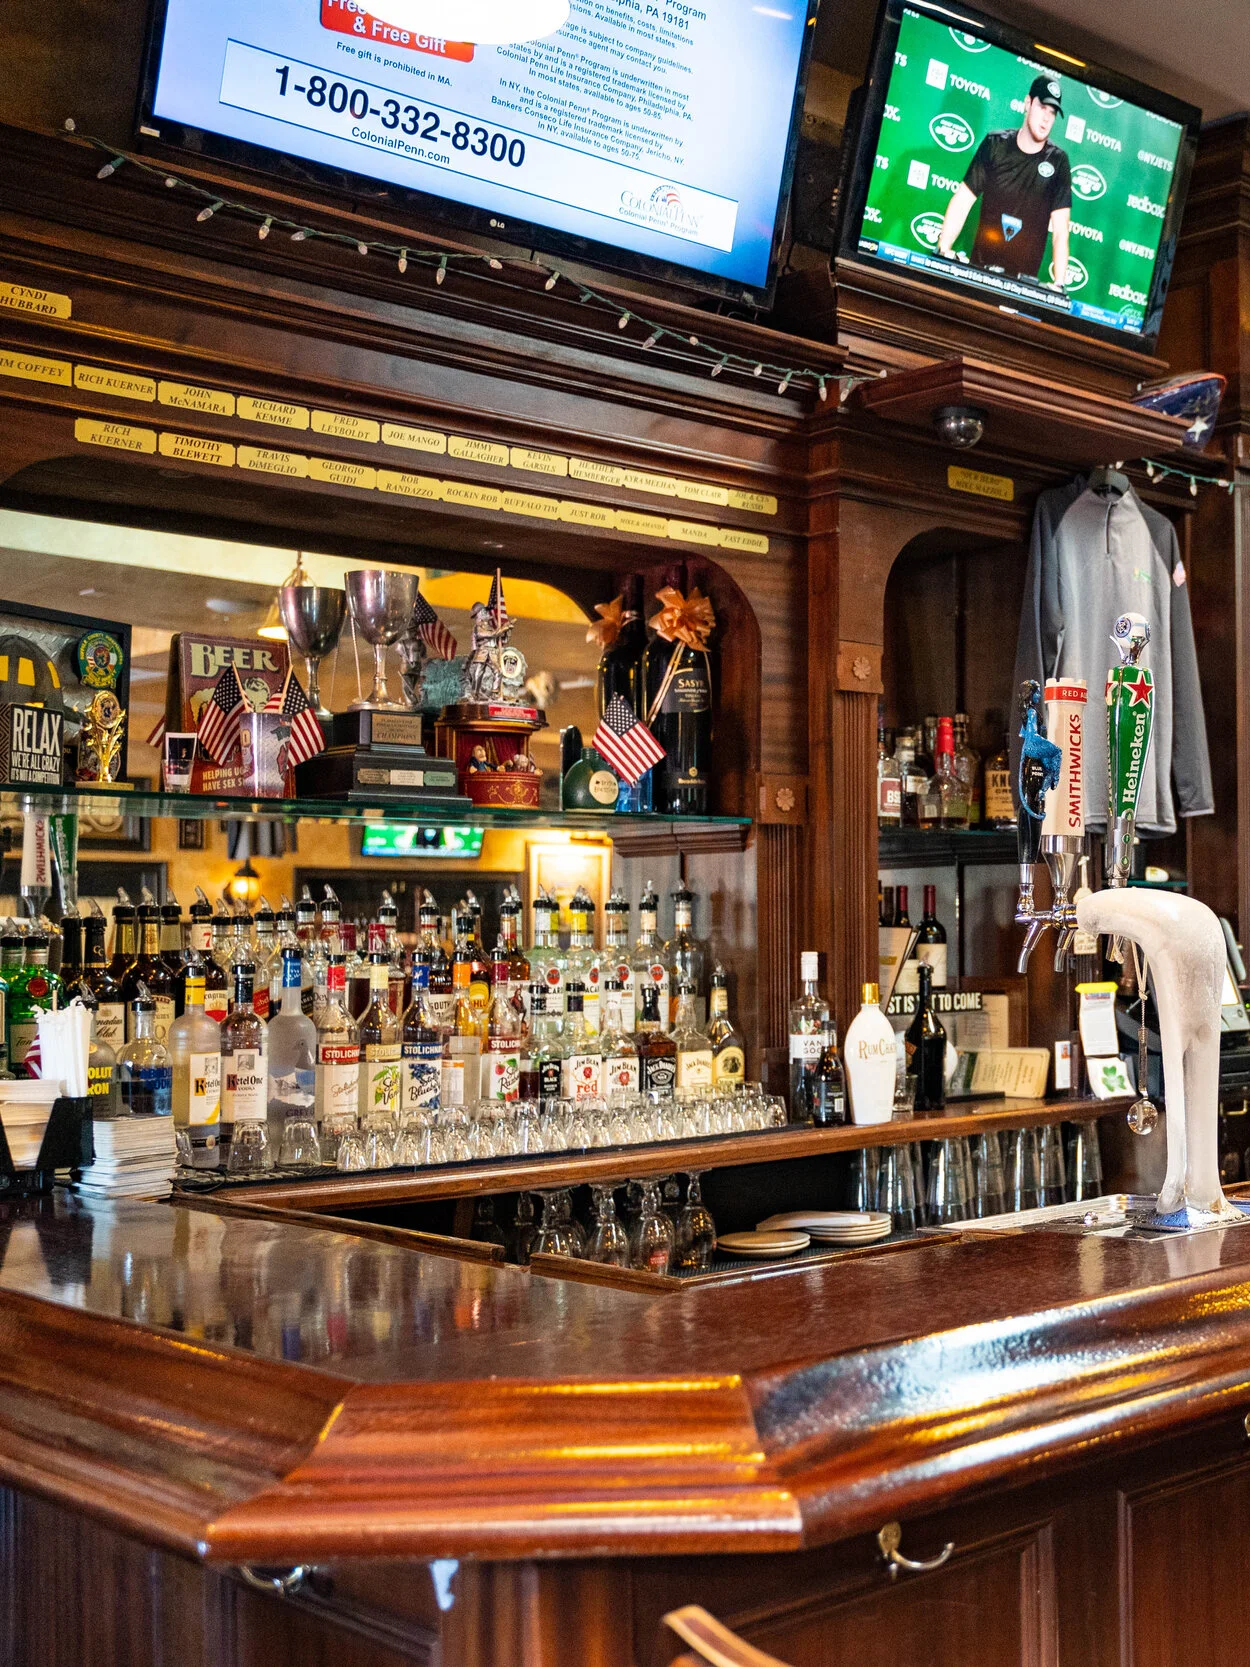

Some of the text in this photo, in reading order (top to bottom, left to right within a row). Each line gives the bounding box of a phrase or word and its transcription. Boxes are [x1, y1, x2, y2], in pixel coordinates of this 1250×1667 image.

[645, 4, 689, 29] PA 19181
[594, 11, 654, 40] Available most
[352, 16, 447, 54] & Free Gift
[336, 42, 453, 86] Free gift is prohibited in MA.
[624, 44, 692, 73] company guidelines.
[625, 54, 652, 68] contact
[496, 46, 637, 102] Colonial Penn Insurance Company,
[537, 72, 615, 103] most available
[950, 74, 990, 101] TOYOTA
[275, 66, 526, 168] 1-800-332-8300
[490, 95, 609, 140] Bankers Conseco Insurance
[536, 90, 674, 142] Colonial Program underwritten
[549, 106, 623, 134] registered trademark
[560, 130, 592, 144] available
[1086, 128, 1122, 152] TOYOTA
[351, 126, 450, 165] ColonialPenn.com
[1137, 150, 1173, 172] @NYJETS
[931, 174, 960, 193] TOYO
[1068, 221, 1103, 243] TOYOTA
[1119, 238, 1155, 260] @NYJETS
[10, 286, 48, 300] CYNDI
[0, 295, 57, 314] HUBBARD
[16, 361, 64, 376] COFFEY
[78, 372, 153, 394] RICH KUERNER
[183, 387, 211, 398] JOHN
[168, 395, 225, 413] McNAMARA
[251, 399, 296, 414] RICHARD
[255, 411, 290, 424] KEMME
[333, 415, 359, 426] FRED
[103, 423, 131, 436] RICH
[321, 423, 369, 439] LEYBOLDT
[90, 433, 142, 449] KUERNER
[174, 436, 222, 451] TIMOTHY
[388, 430, 440, 446] JOE MANGO
[464, 440, 492, 451] JIMMY
[172, 447, 222, 462] BLEWETT
[256, 449, 290, 462] TRAVIS
[453, 446, 504, 464] GALLAGHER
[526, 449, 553, 461] KEVIN
[248, 459, 297, 473] DiMEGLIO
[321, 461, 365, 474] GEORGIO
[578, 461, 616, 473] HEATHER
[329, 473, 357, 484] GUIDI
[400, 474, 419, 484] ROB
[624, 473, 645, 486] KYRA
[385, 482, 433, 496] RANDAZZO
[446, 488, 498, 502] ROCKIN ROB
[684, 484, 722, 500] TOM CLAIR
[503, 497, 558, 513] BUFFALO TIM
[569, 509, 606, 520] JUST ROB
[724, 534, 763, 547] FAST EDDIE
[190, 642, 279, 678] BEER
[13, 708, 61, 757] RELAX
[12, 752, 60, 771] WE'RE ALL CRAZY
[1122, 712, 1146, 803] Heineken
[203, 768, 232, 780] HELPING
[1069, 714, 1081, 828] SMITHWICKS
[203, 780, 235, 792] HAVE SEX
[203, 932, 211, 948] 7
[904, 996, 913, 1012] IS
[938, 994, 952, 1010] TO
[954, 993, 981, 1010] COME
[325, 1050, 359, 1059] STOLICHN
[88, 1066, 112, 1079] OLUT
[574, 1059, 584, 1070] JIM
[610, 1062, 637, 1075] JIM BEAM
[647, 1062, 659, 1073] JACK
[87, 1082, 110, 1095] RON
[194, 1078, 214, 1096] Ketel
[227, 1074, 263, 1090] Ketel One
[577, 1080, 597, 1094] red
